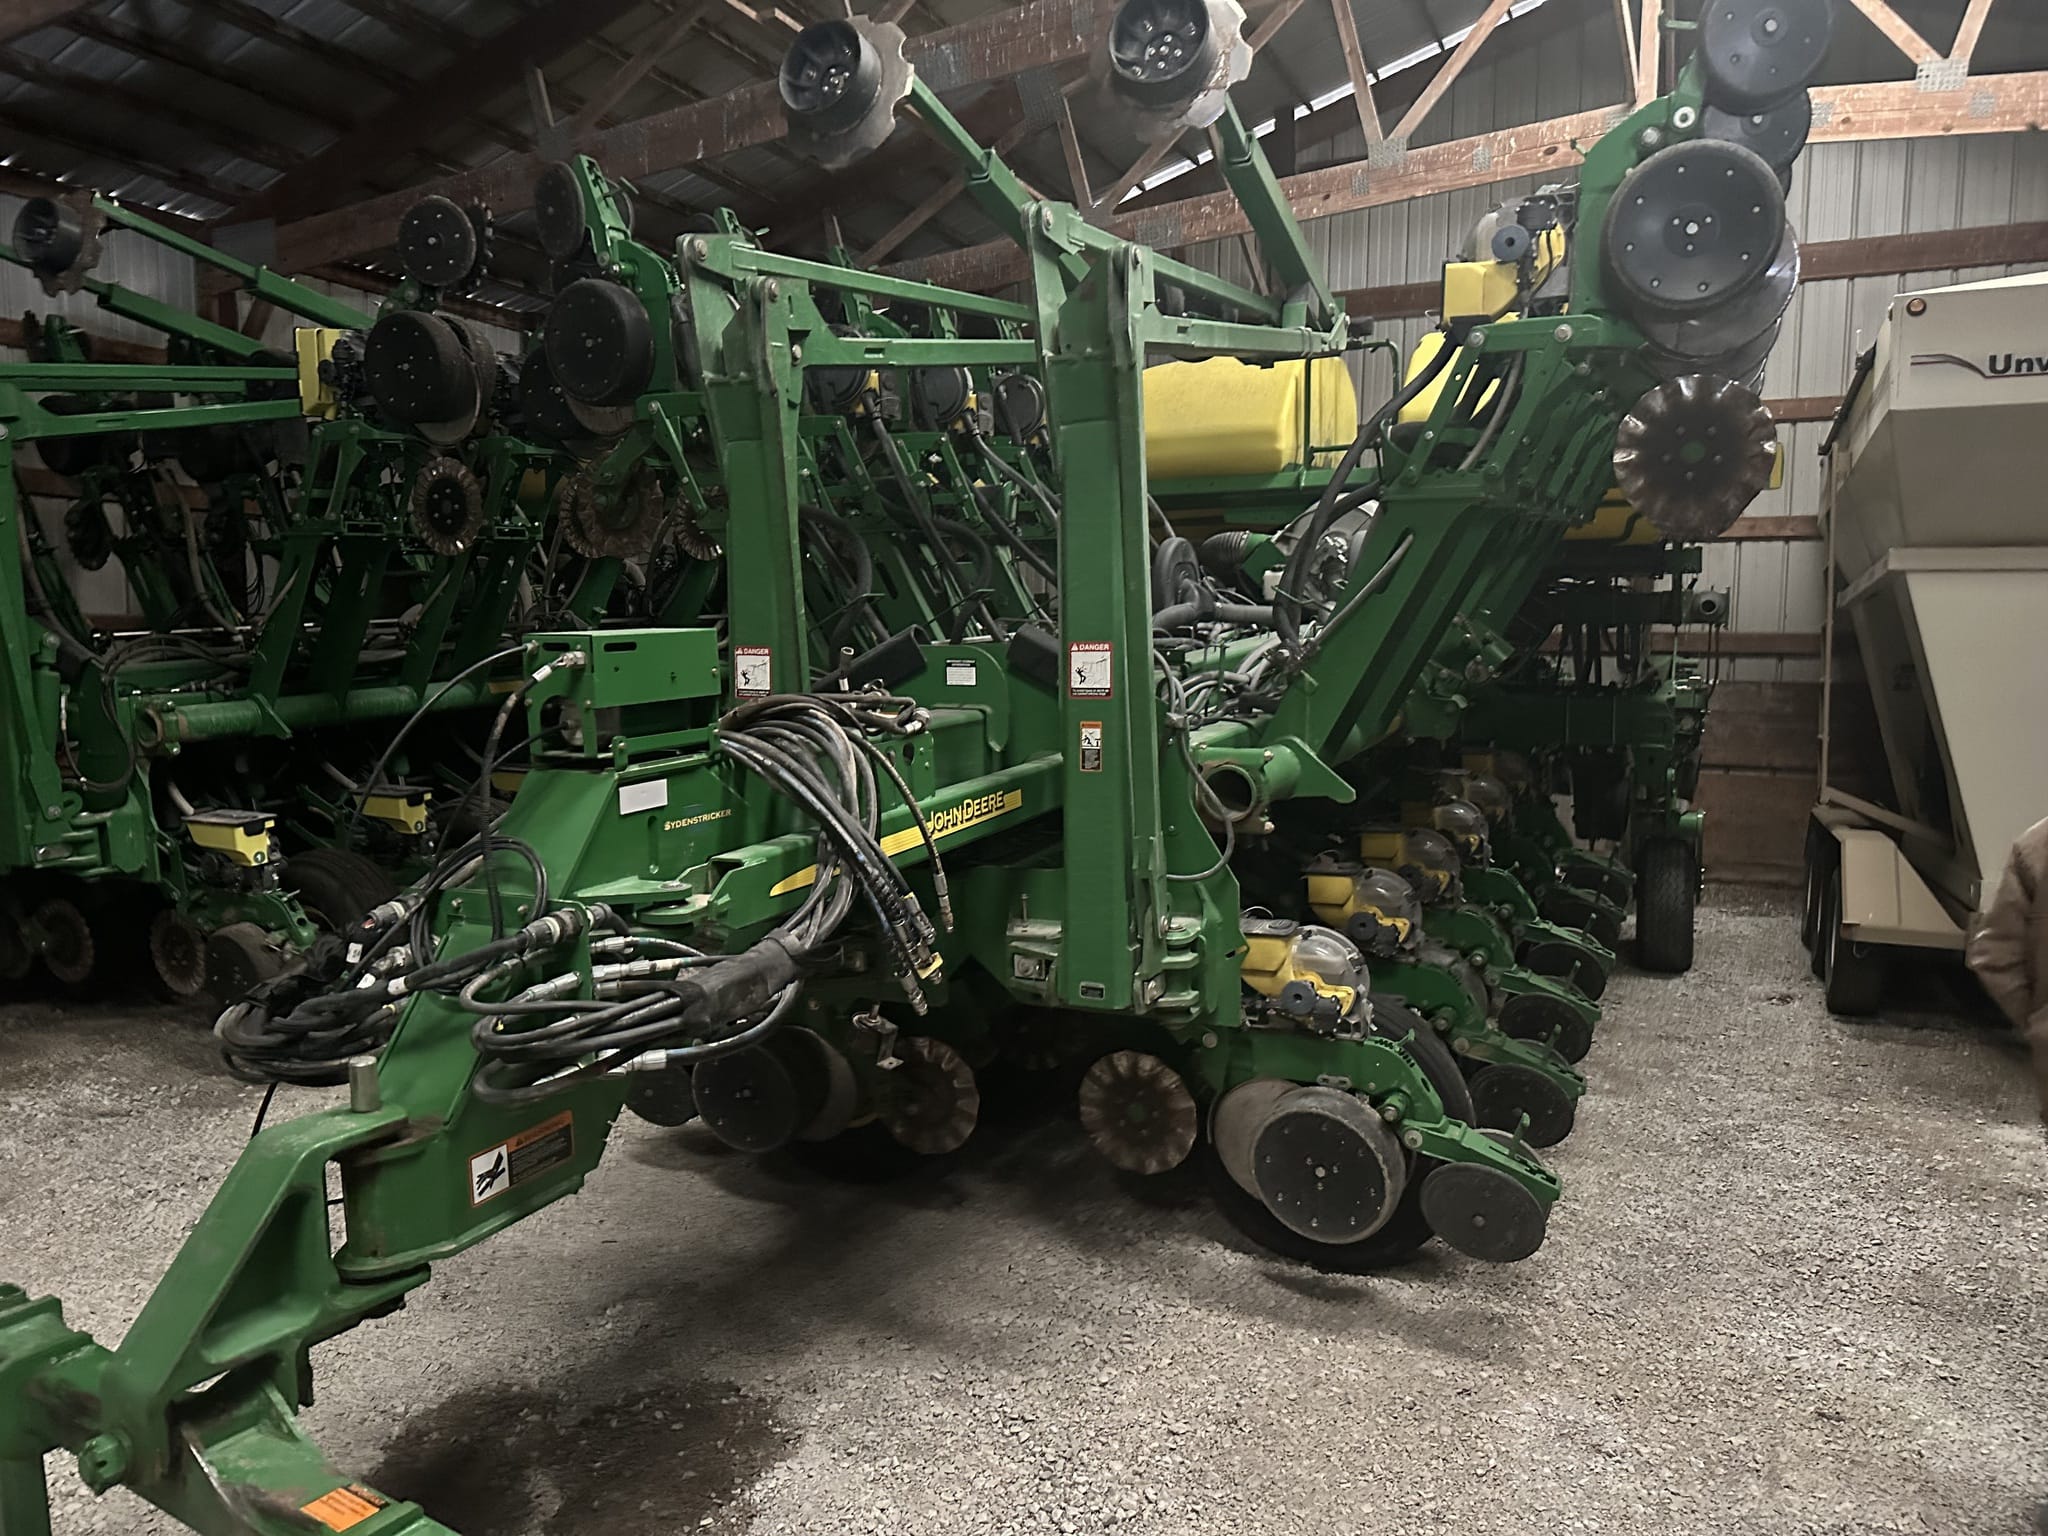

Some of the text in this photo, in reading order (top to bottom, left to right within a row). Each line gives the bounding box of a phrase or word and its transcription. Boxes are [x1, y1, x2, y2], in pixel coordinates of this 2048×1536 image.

[743, 647, 769, 655] DANGER
[1079, 643, 1110, 651] DANGER
[663, 808, 732, 831] SYDENSTRICKER
